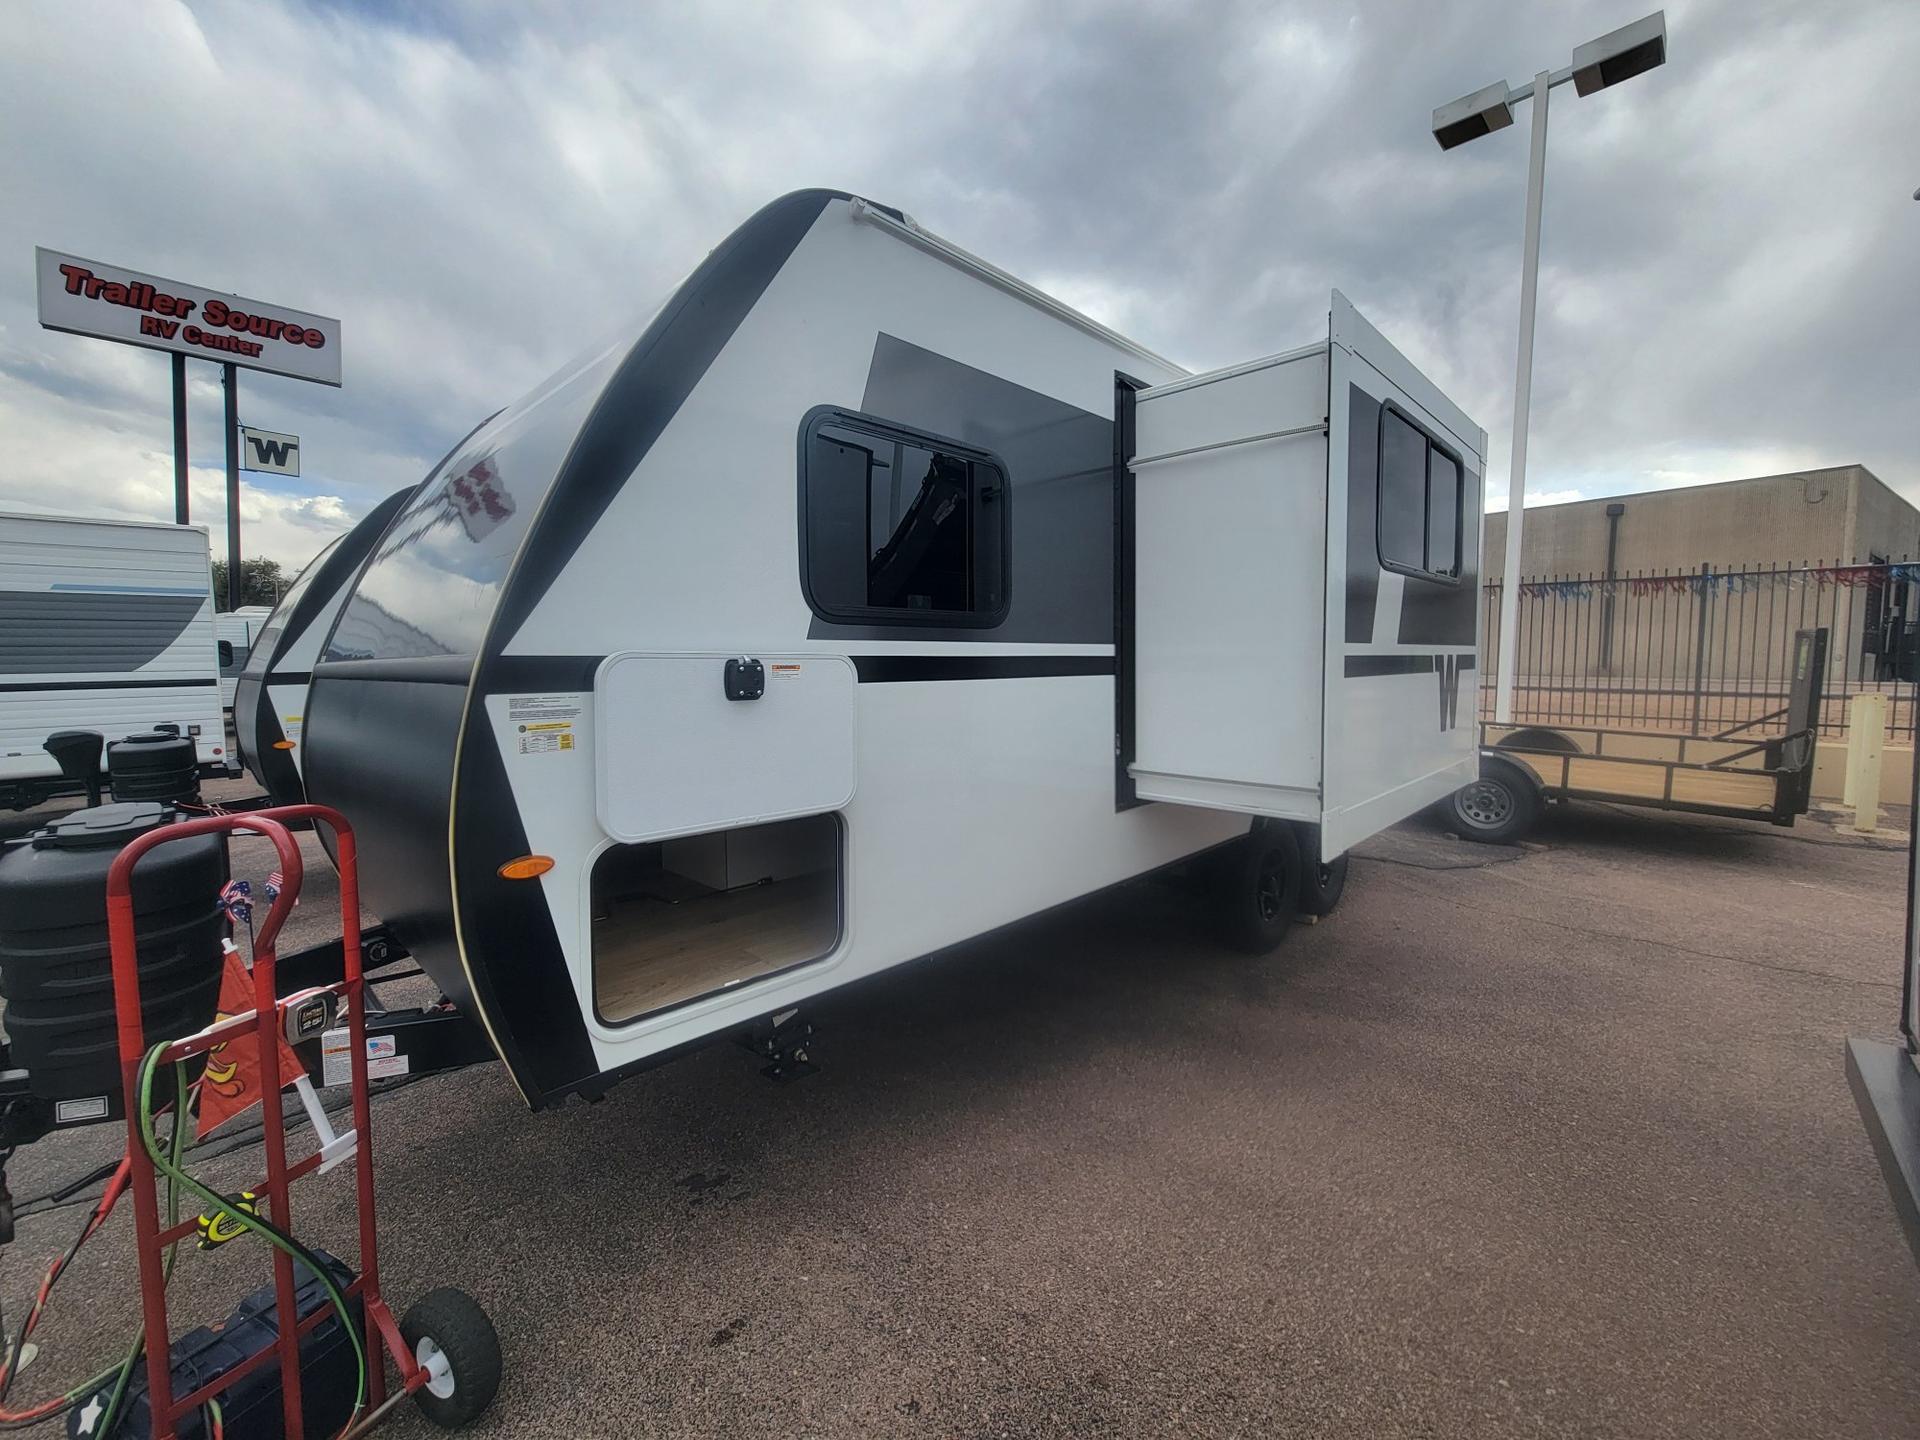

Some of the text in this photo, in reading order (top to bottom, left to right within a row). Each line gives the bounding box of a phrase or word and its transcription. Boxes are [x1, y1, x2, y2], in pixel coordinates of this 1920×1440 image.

[59, 263, 325, 349] Trailer Source
[140, 315, 263, 358] RV Center
[247, 436, 298, 467] W
